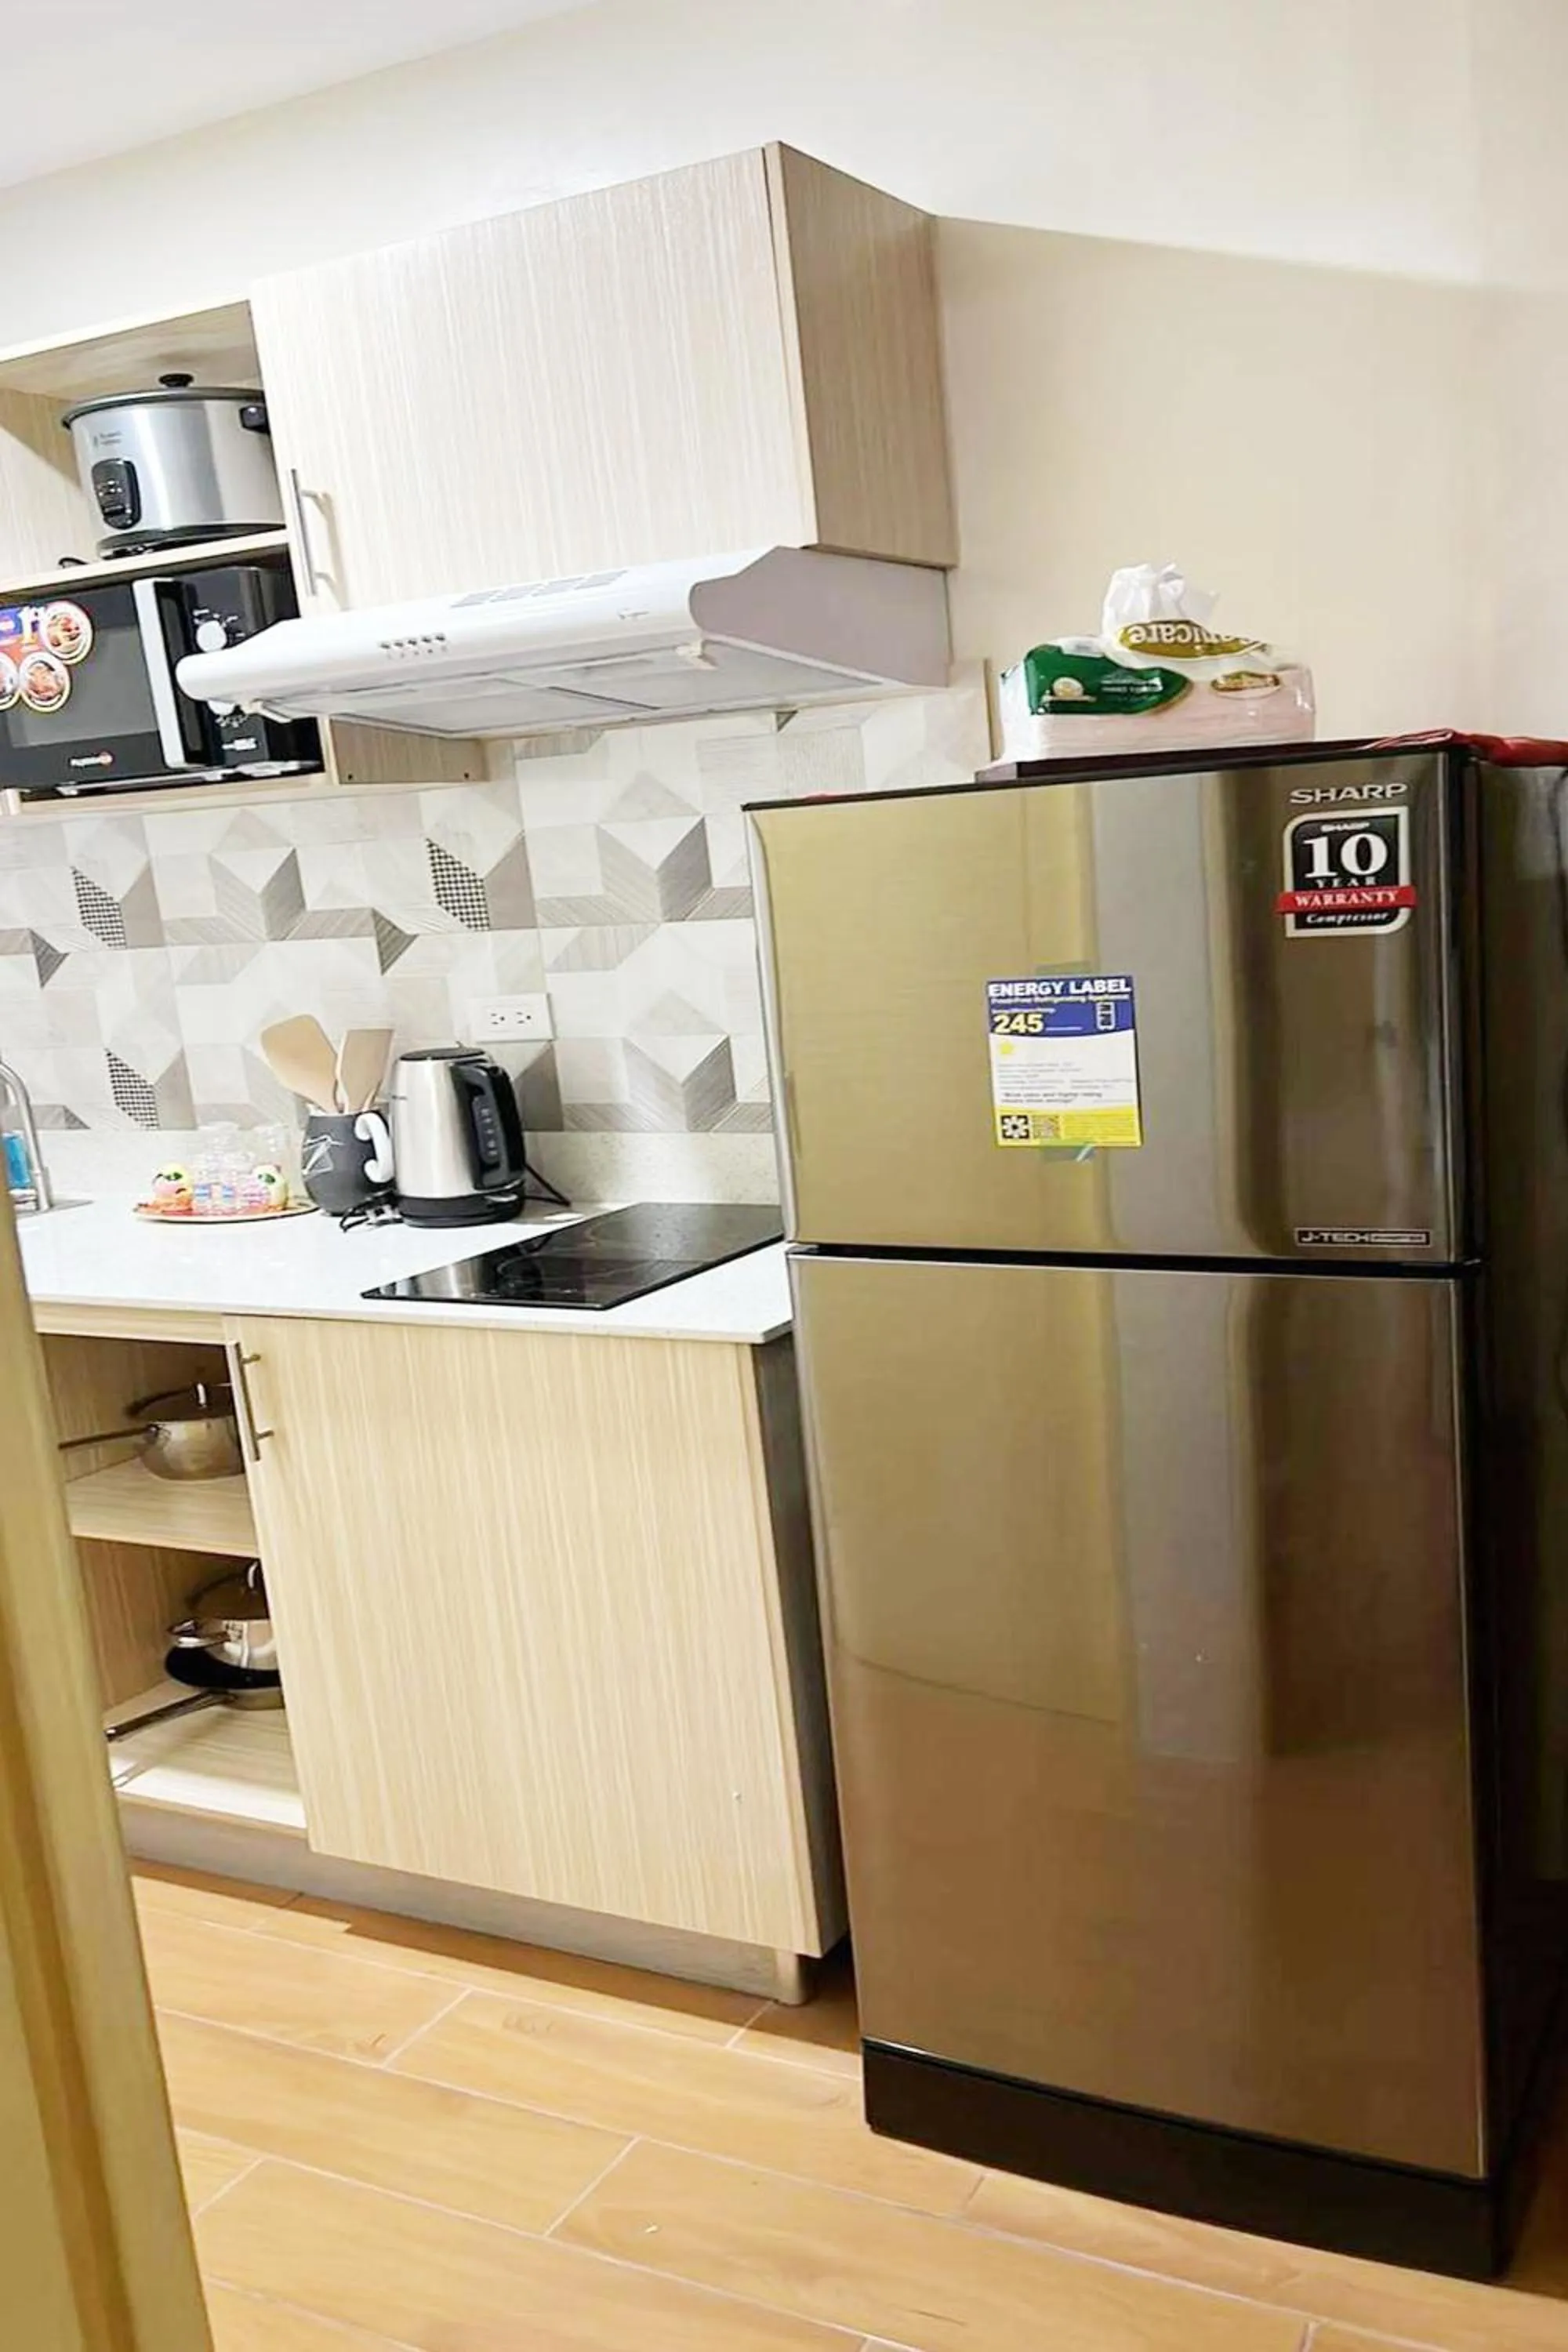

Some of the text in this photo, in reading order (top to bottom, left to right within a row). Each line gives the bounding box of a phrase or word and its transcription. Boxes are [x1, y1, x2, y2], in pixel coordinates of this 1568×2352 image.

[1128, 624, 1252, 652] nicare
[1290, 783, 1408, 804] SHARP
[1303, 833, 1388, 877] 10
[1295, 891, 1398, 906] WARRANTY
[989, 978, 1131, 996] ENERGY LABEL
[993, 1013, 1044, 1033] 245
